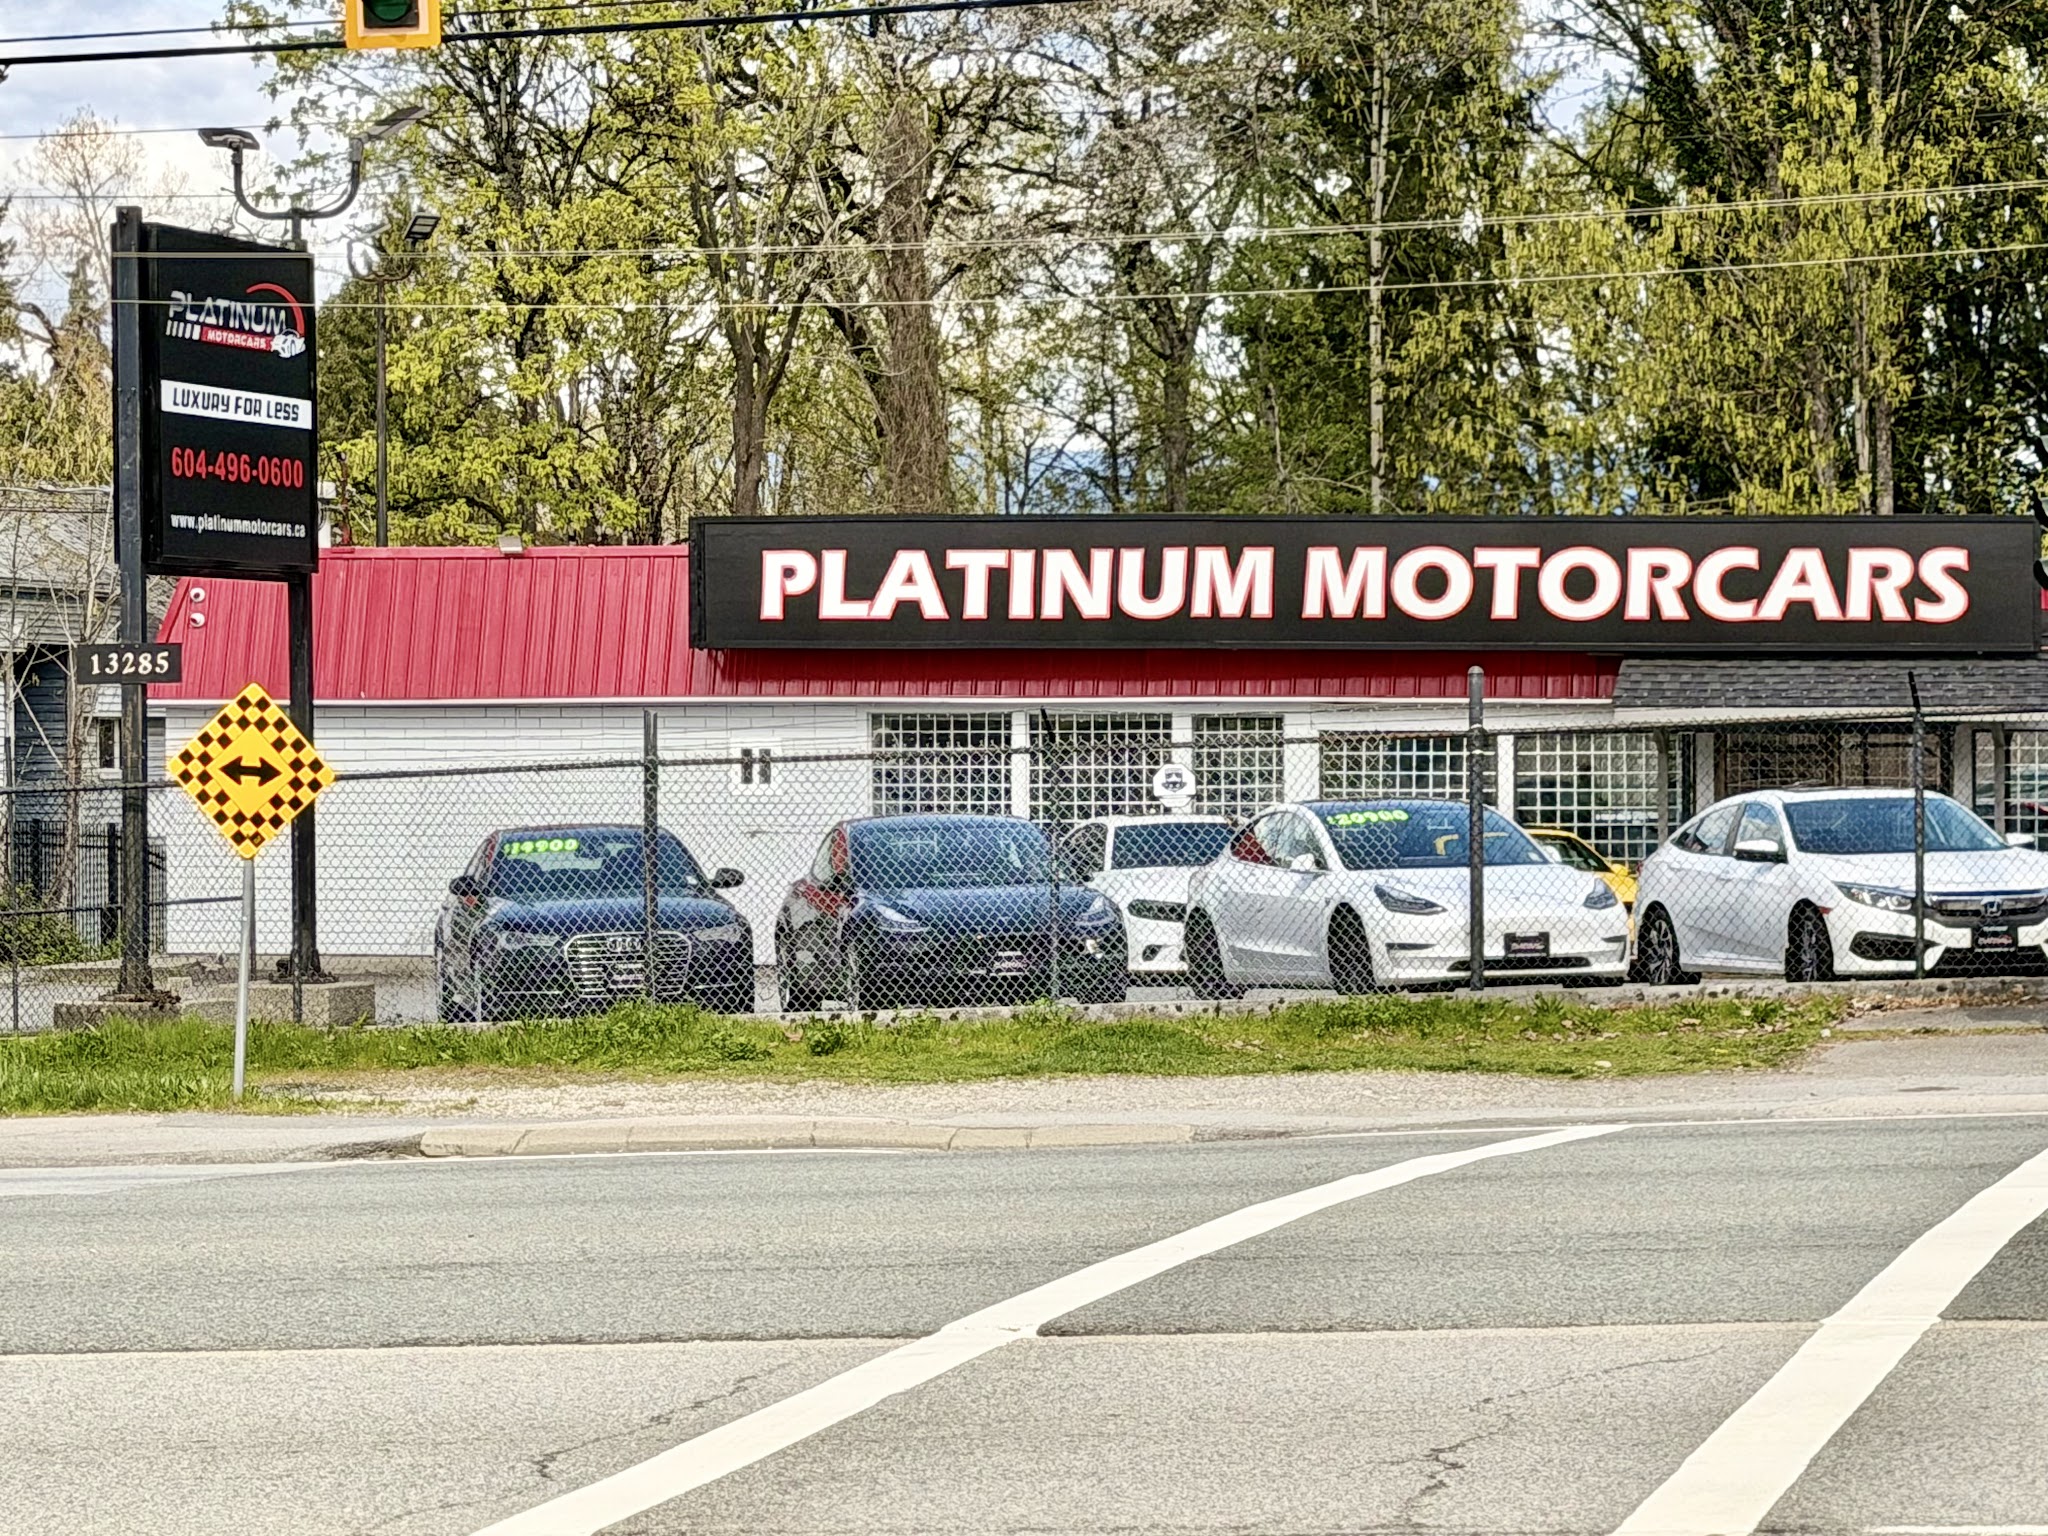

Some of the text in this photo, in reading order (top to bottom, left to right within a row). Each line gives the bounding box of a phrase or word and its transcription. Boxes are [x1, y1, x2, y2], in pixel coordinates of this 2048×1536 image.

[168, 290, 287, 335] PLATINUM
[206, 330, 267, 349] MOTORCARS
[173, 387, 230, 413] LUXURY
[234, 396, 262, 417] FOR
[171, 447, 304, 488] 604-496-0600
[170, 513, 306, 538] www.platinummotorcars.ca
[760, 546, 1969, 622] PLATINUM MOTORCARS
[90, 651, 169, 675] 13285
